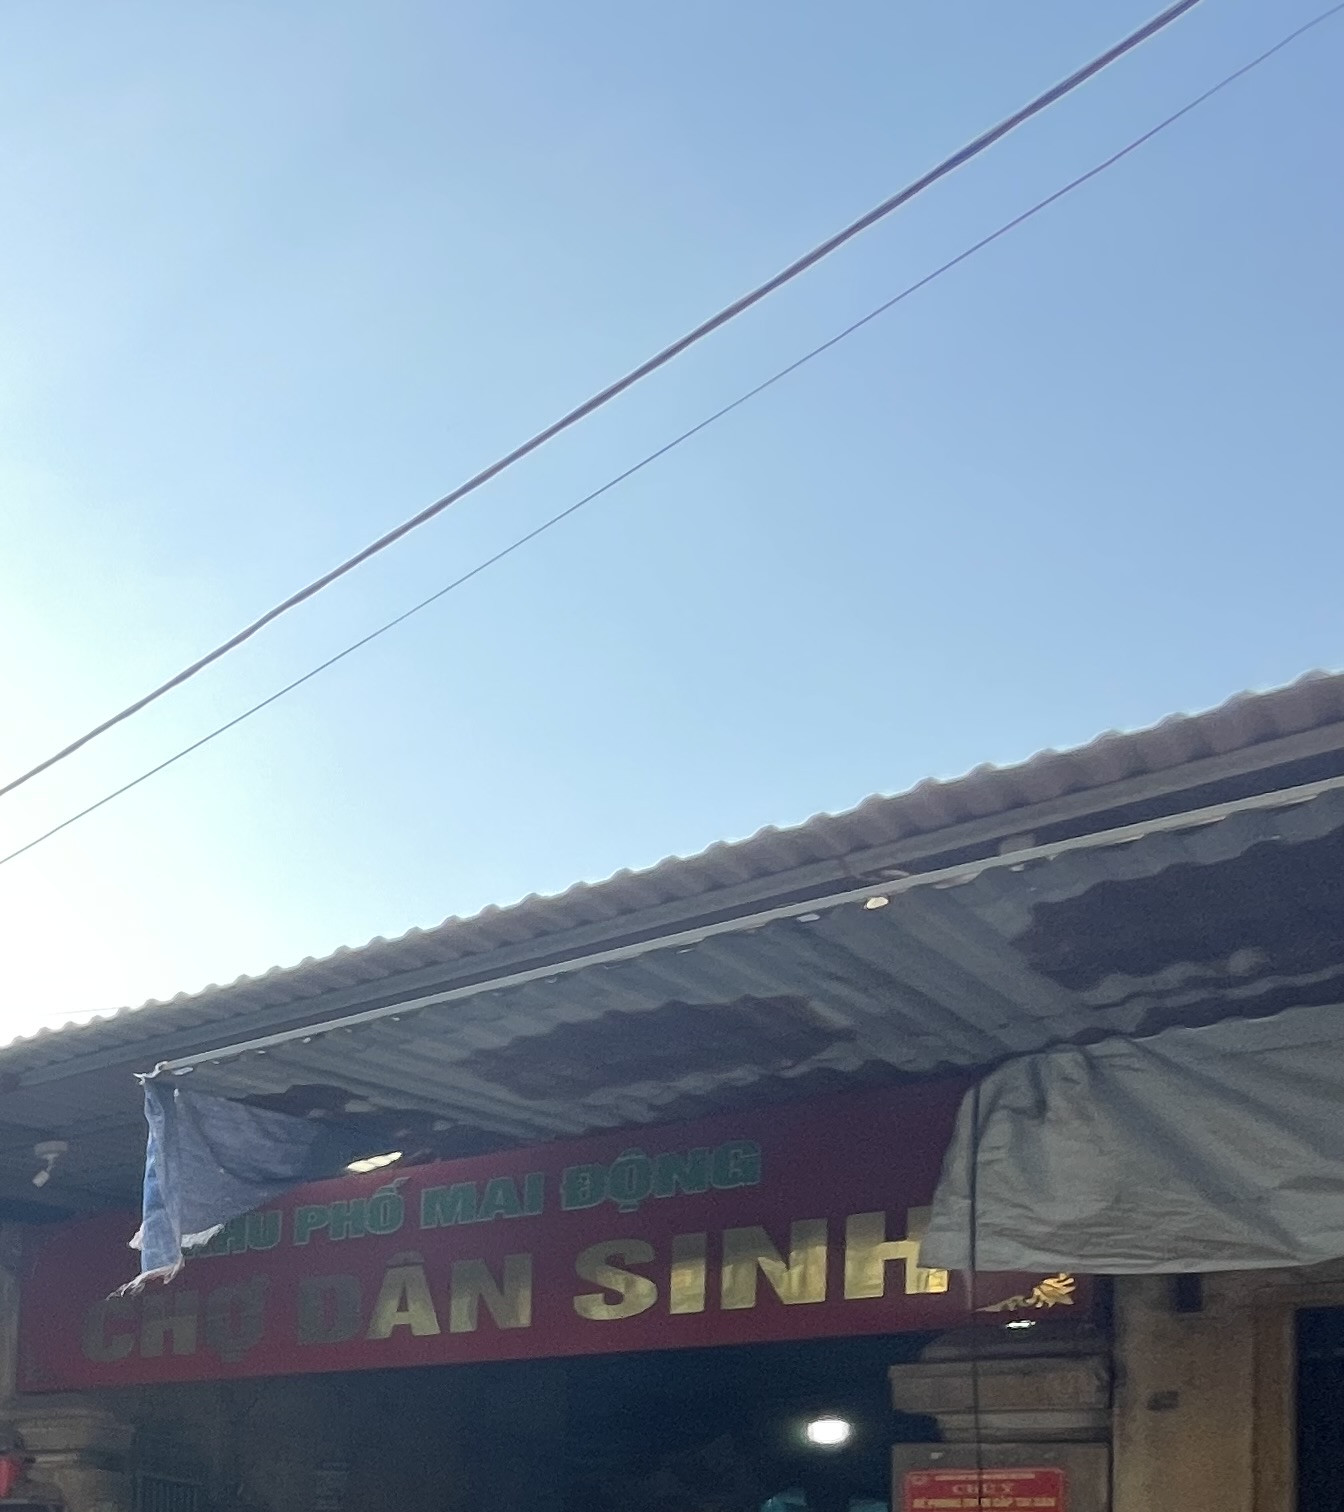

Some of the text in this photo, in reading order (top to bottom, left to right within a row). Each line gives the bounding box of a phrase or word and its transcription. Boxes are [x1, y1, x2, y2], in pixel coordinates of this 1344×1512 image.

[293, 1177, 410, 1246] PHỐ
[420, 1171, 546, 1230] MAI
[560, 1139, 761, 1213] ĐỘNG
[81, 1205, 950, 1364] CHỢ DÂN SINH
